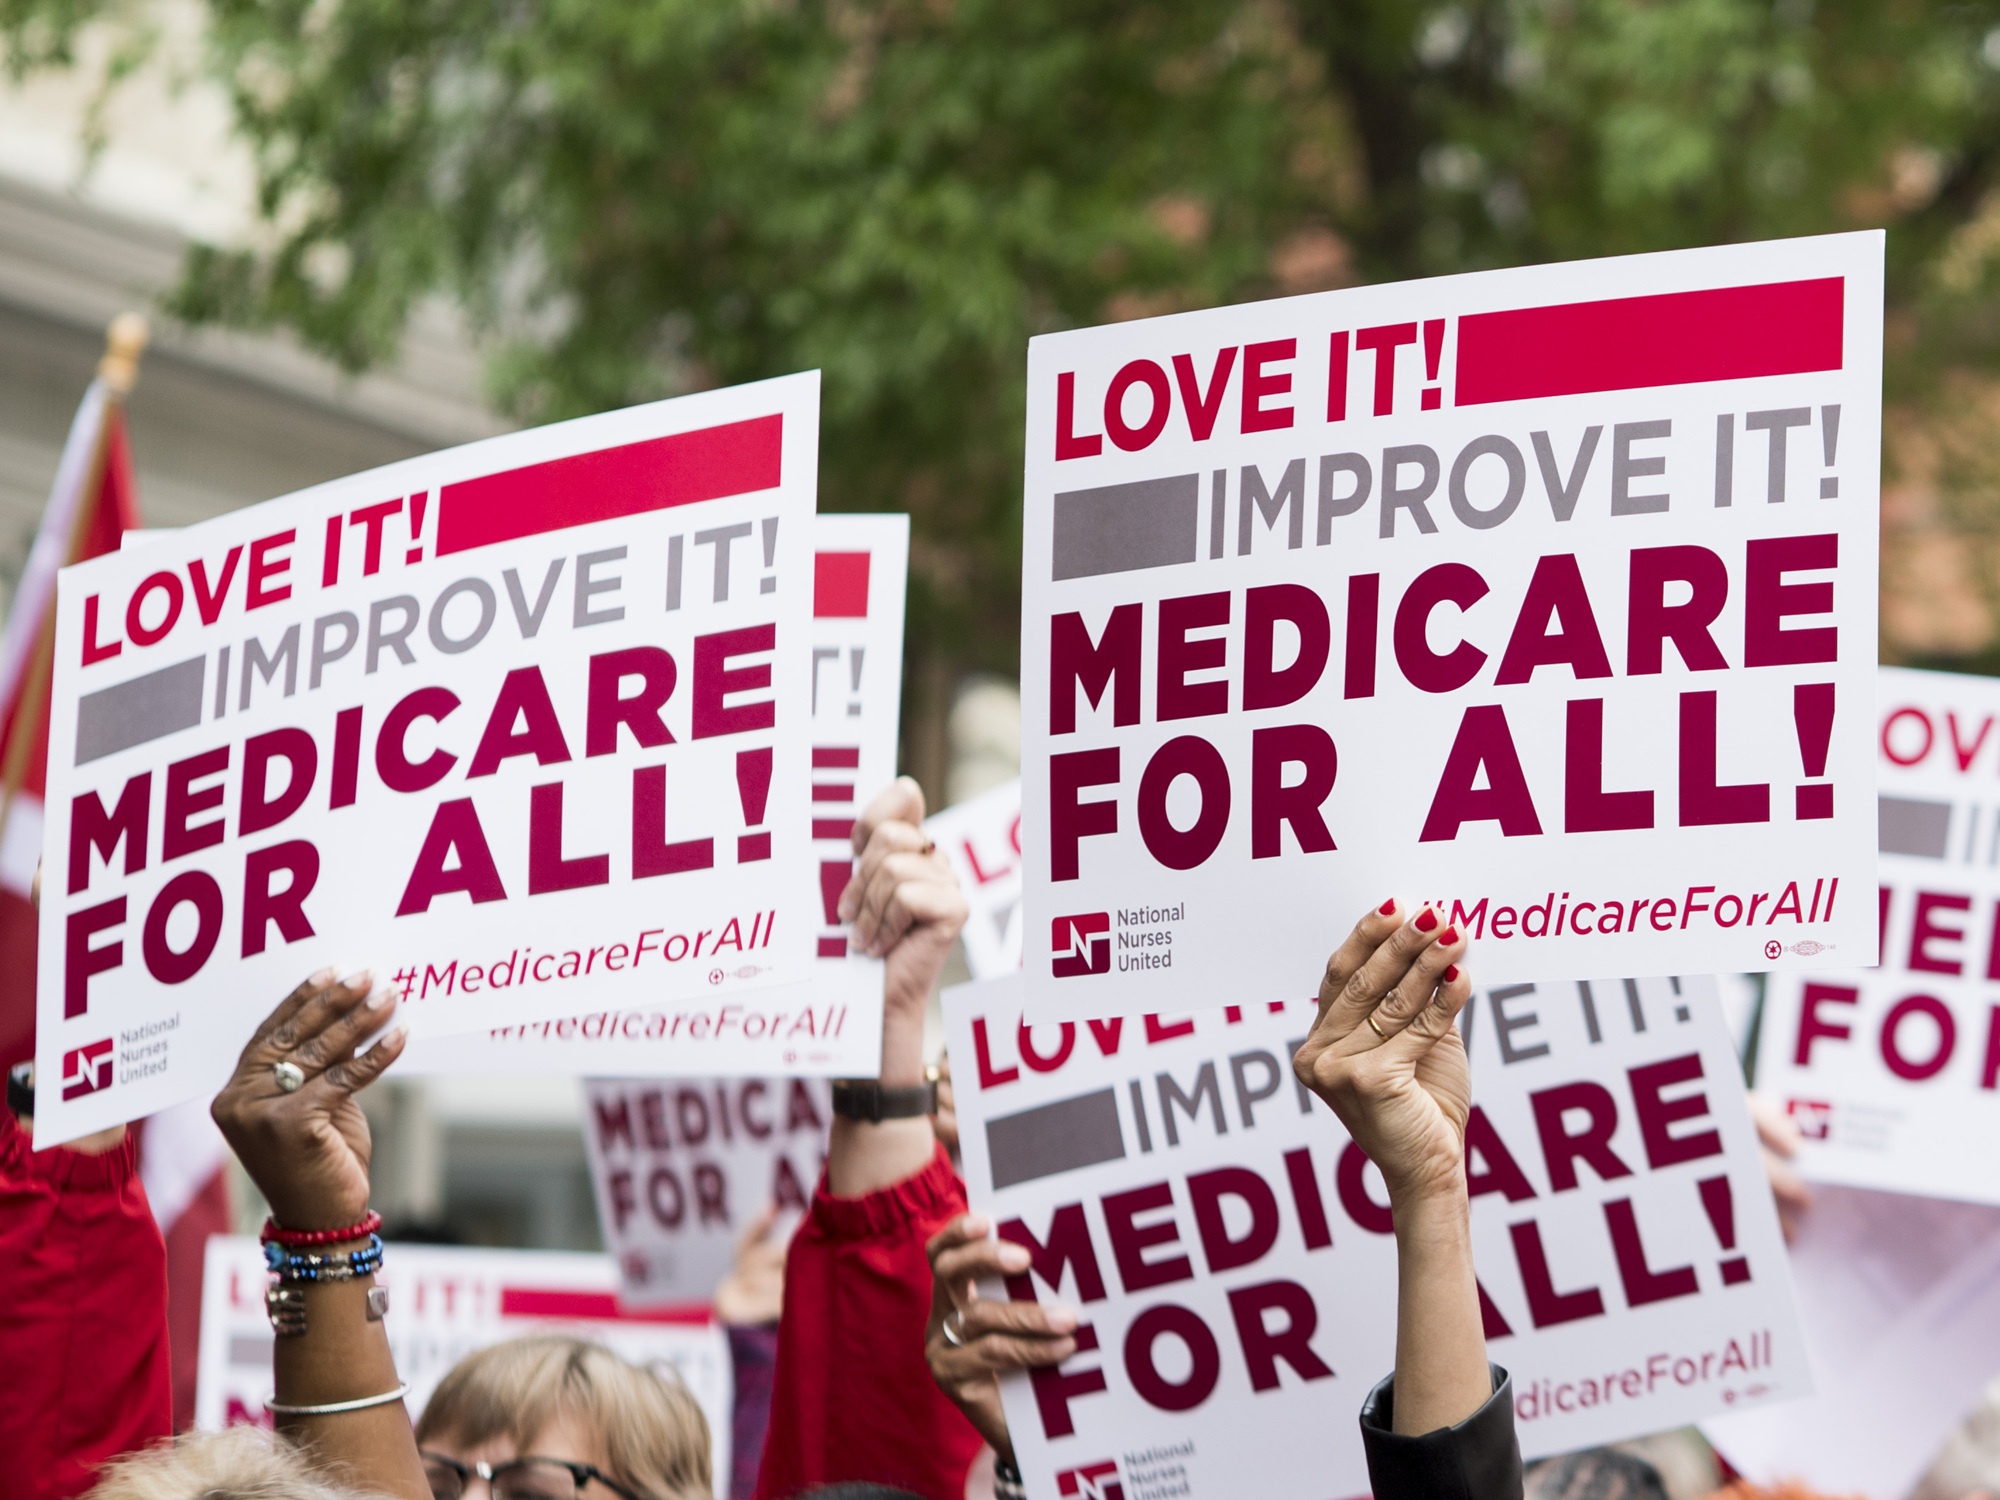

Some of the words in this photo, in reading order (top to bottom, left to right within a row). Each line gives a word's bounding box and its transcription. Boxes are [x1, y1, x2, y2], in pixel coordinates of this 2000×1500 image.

[1055, 337, 1297, 462] LOVE
[1327, 317, 1446, 424] IT!
[1210, 418, 1672, 561] IMPROVE
[1715, 403, 1842, 509] IT!
[80, 527, 297, 668] LOVE
[321, 489, 431, 589] IT!
[214, 545, 630, 721] IMPROVE
[665, 515, 780, 612] IT!
[1049, 533, 1839, 737] MEDICARE
[66, 622, 777, 897] MEDICARE
[1049, 723, 1339, 884] FOR
[1418, 682, 1836, 844] ALL!
[63, 838, 321, 1021] FOR
[394, 745, 774, 918] ALL!
[1117, 902, 1185, 927] National
[1423, 877, 1840, 941] MedicareForAll
[391, 909, 776, 1003] #MedicareForAll
[1117, 930, 1173, 950] Nurses
[1117, 949, 1172, 972] United
[119, 1057, 168, 1086] United
[120, 1011, 181, 1045] National
[120, 1039, 168, 1065] Nurses
[1792, 980, 2000, 1094] FO
[608, 1161, 733, 1234] FOR
[1513, 1328, 1772, 1422] dicareForAll
[1123, 1438, 1196, 1467] National
